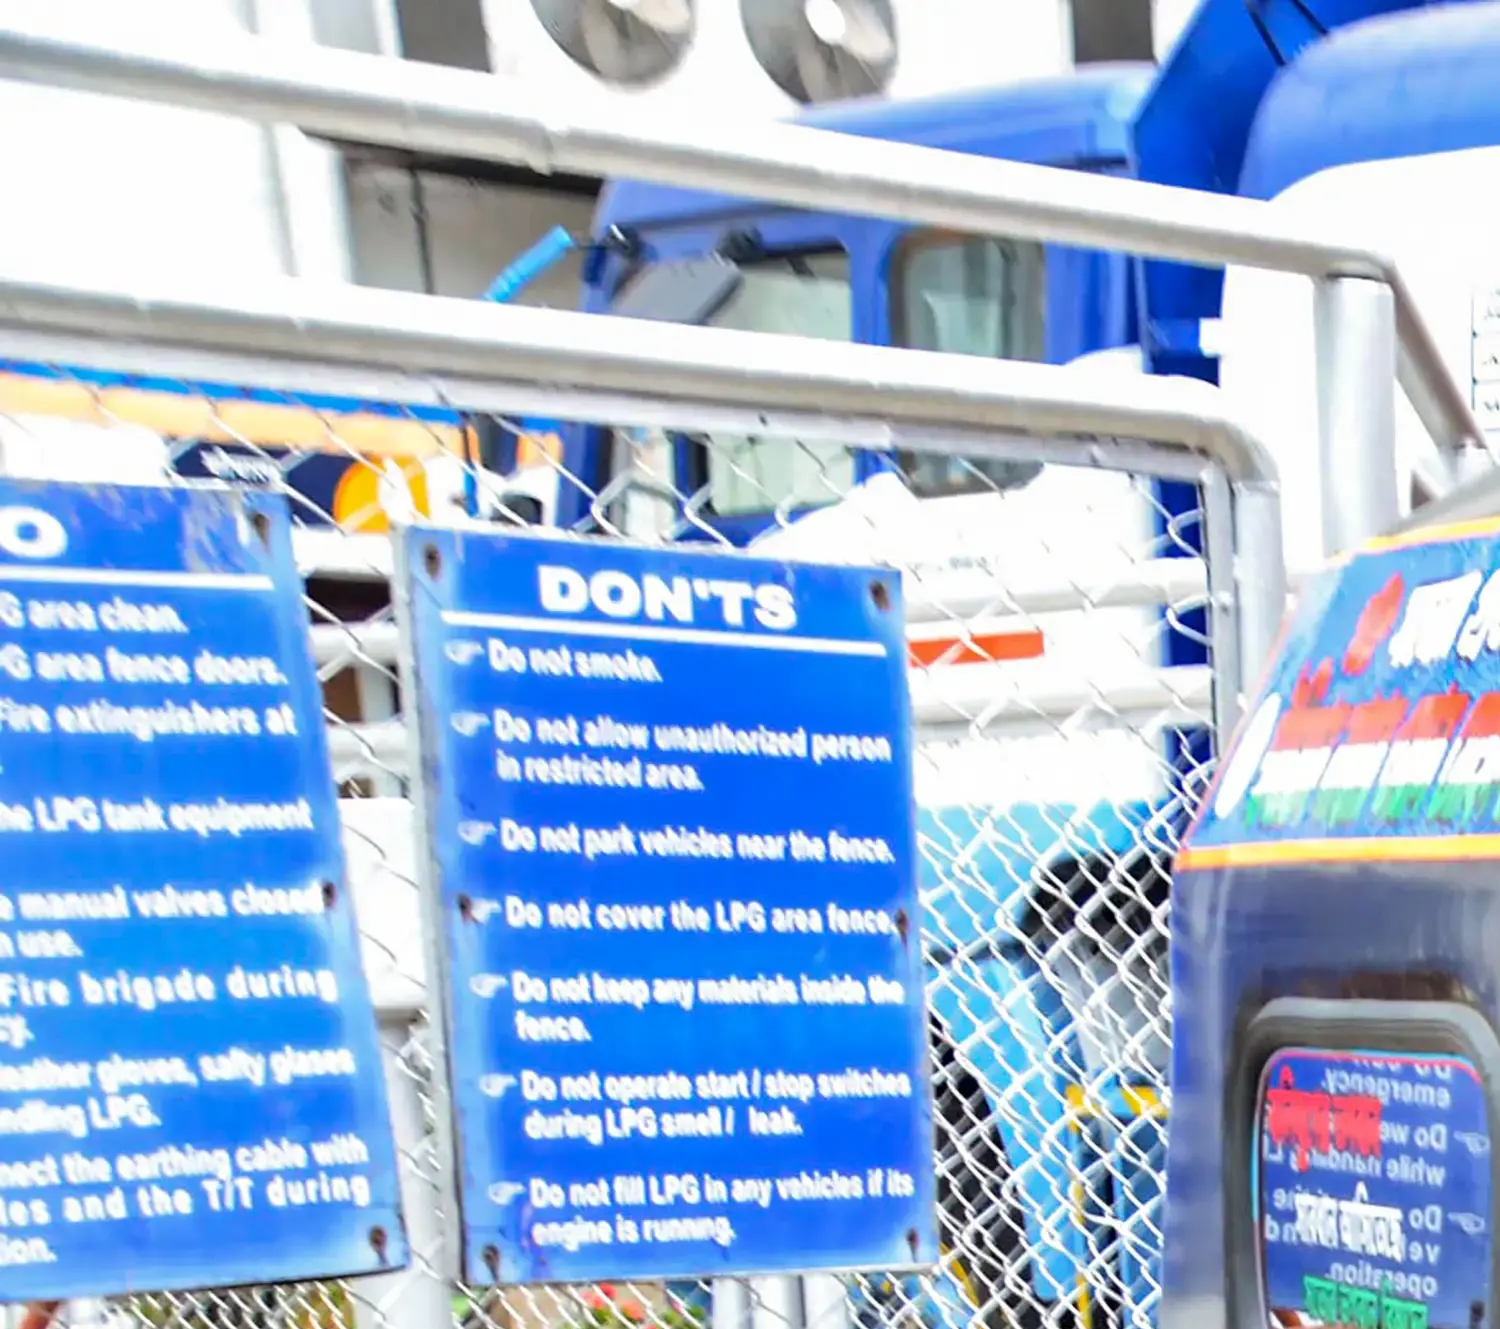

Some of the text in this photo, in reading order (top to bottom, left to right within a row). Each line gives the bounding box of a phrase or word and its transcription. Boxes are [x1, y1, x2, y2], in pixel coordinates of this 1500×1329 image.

[0, 506, 68, 558] O
[28, 599, 98, 631] area
[100, 595, 189, 633] clean.
[538, 565, 797, 630] DON'TS
[35, 652, 104, 682] area
[105, 646, 192, 684] fence
[193, 648, 289, 685] doors.
[488, 638, 663, 683] Do not smoke.
[54, 697, 261, 743] extinguishers
[265, 702, 298, 737] at
[494, 708, 891, 765] Do not allow unauthorized person
[497, 749, 704, 792] in restricted area.
[34, 796, 101, 833] LPG
[101, 797, 169, 831] tank
[169, 797, 315, 838] equipment
[501, 818, 896, 863] Do not park vehicles near the fence.
[18, 884, 131, 921] manual
[131, 884, 228, 918] valves
[230, 881, 325, 916] closed
[506, 895, 898, 936] Do not cover the LPG area fence.
[78, 968, 216, 1011] brigade
[225, 964, 339, 1004] during
[512, 970, 906, 1012] Do not keep any materials inside the
[515, 1009, 592, 1043] fence.
[521, 1068, 556, 1101] Do
[560, 1071, 601, 1100] not
[604, 1071, 692, 1104] operate
[695, 1069, 748, 1099] start
[765, 1069, 815, 1103] stop
[817, 1067, 912, 1098] switches
[523, 1110, 603, 1146] during
[605, 1105, 657, 1139] LPG
[661, 1105, 722, 1138] smell
[748, 1105, 803, 1137] leak.
[61, 1151, 113, 1185] the
[115, 1143, 234, 1183] earthing
[234, 1136, 308, 1173] cable
[310, 1132, 370, 1167] with
[62, 1186, 127, 1224] and
[135, 1183, 194, 1218] the
[201, 1175, 254, 1213] T/T
[265, 1169, 371, 1209] during
[529, 1167, 914, 1210] Do not fill LPG in any vehicles if its
[531, 1213, 737, 1253] engine is running.
